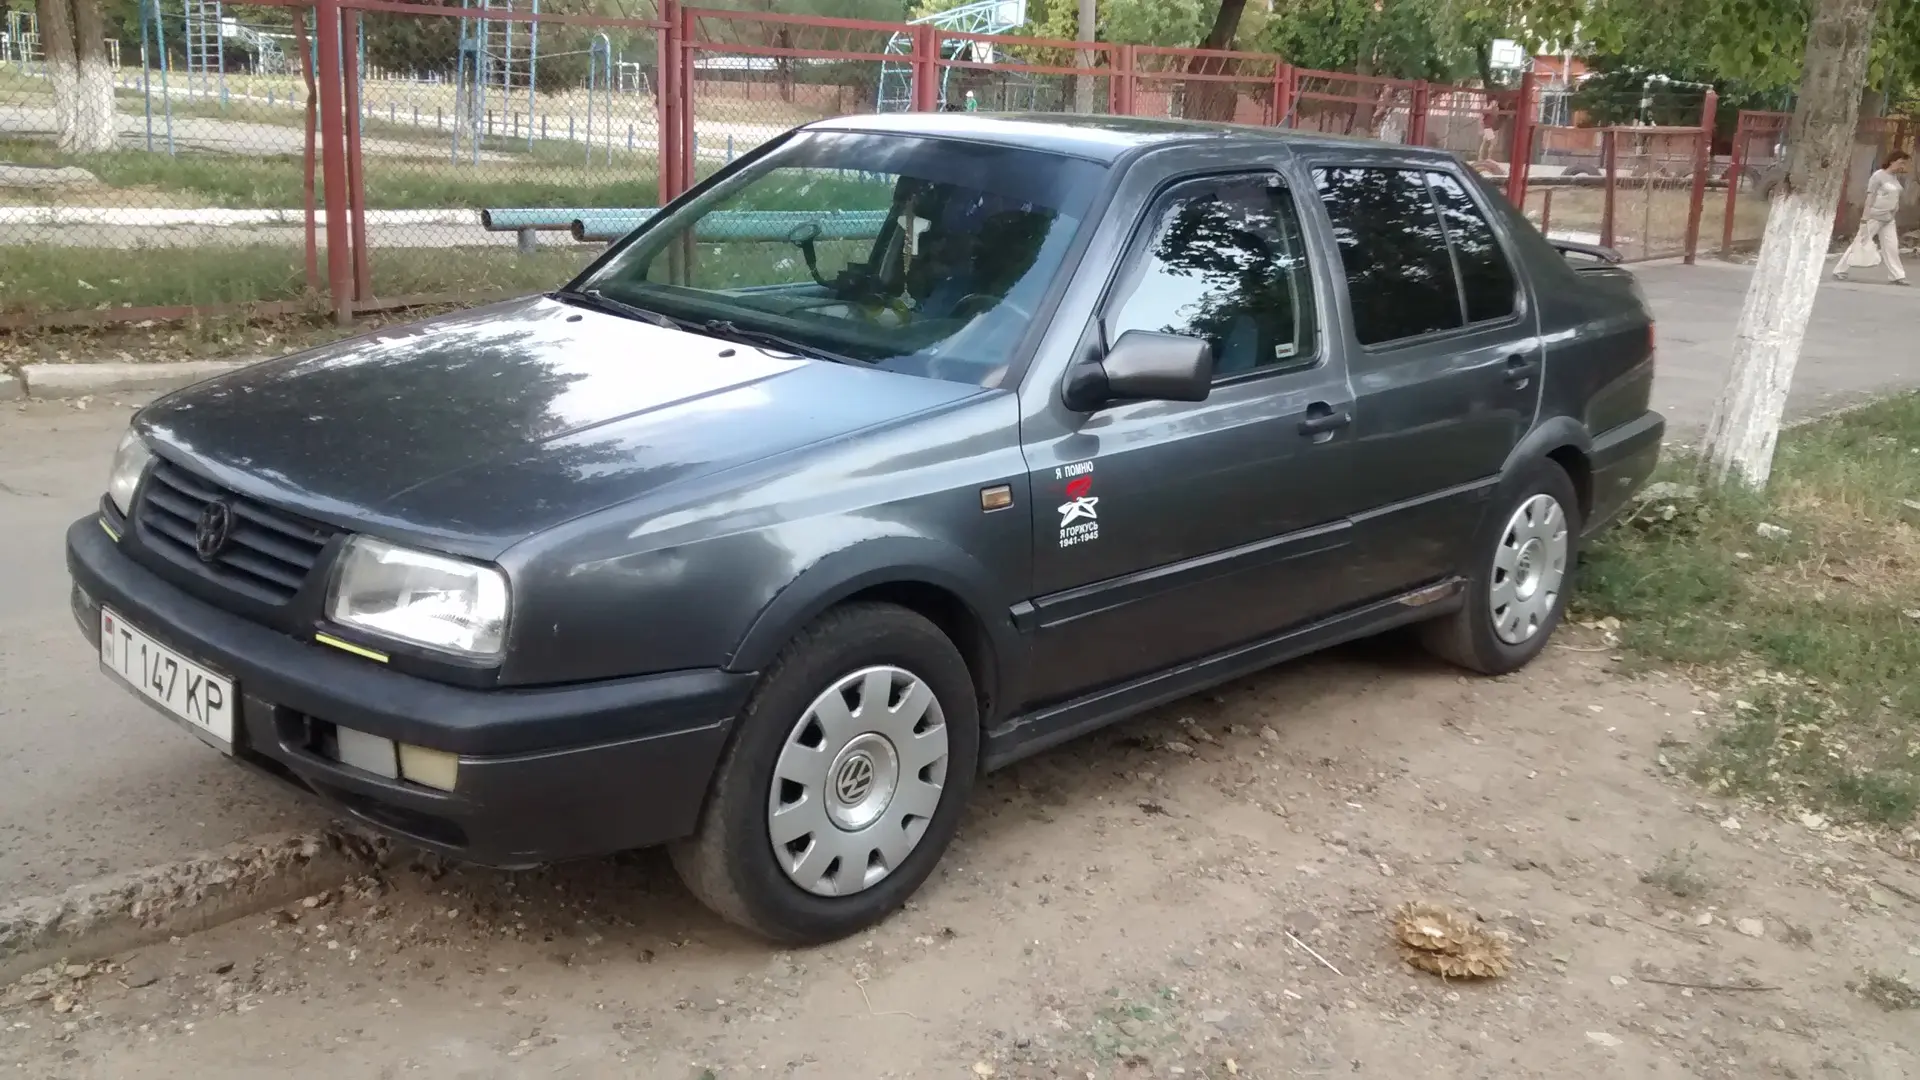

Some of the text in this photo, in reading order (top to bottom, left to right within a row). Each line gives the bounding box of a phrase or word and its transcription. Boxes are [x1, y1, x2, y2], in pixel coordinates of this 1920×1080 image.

[1055, 461, 1094, 480] Я ПОМНЮ
[1059, 521, 1099, 539] Я ГОРЖУСЬ
[1059, 531, 1099, 548] 1941-1945
[120, 627, 223, 725] T 147 KP
